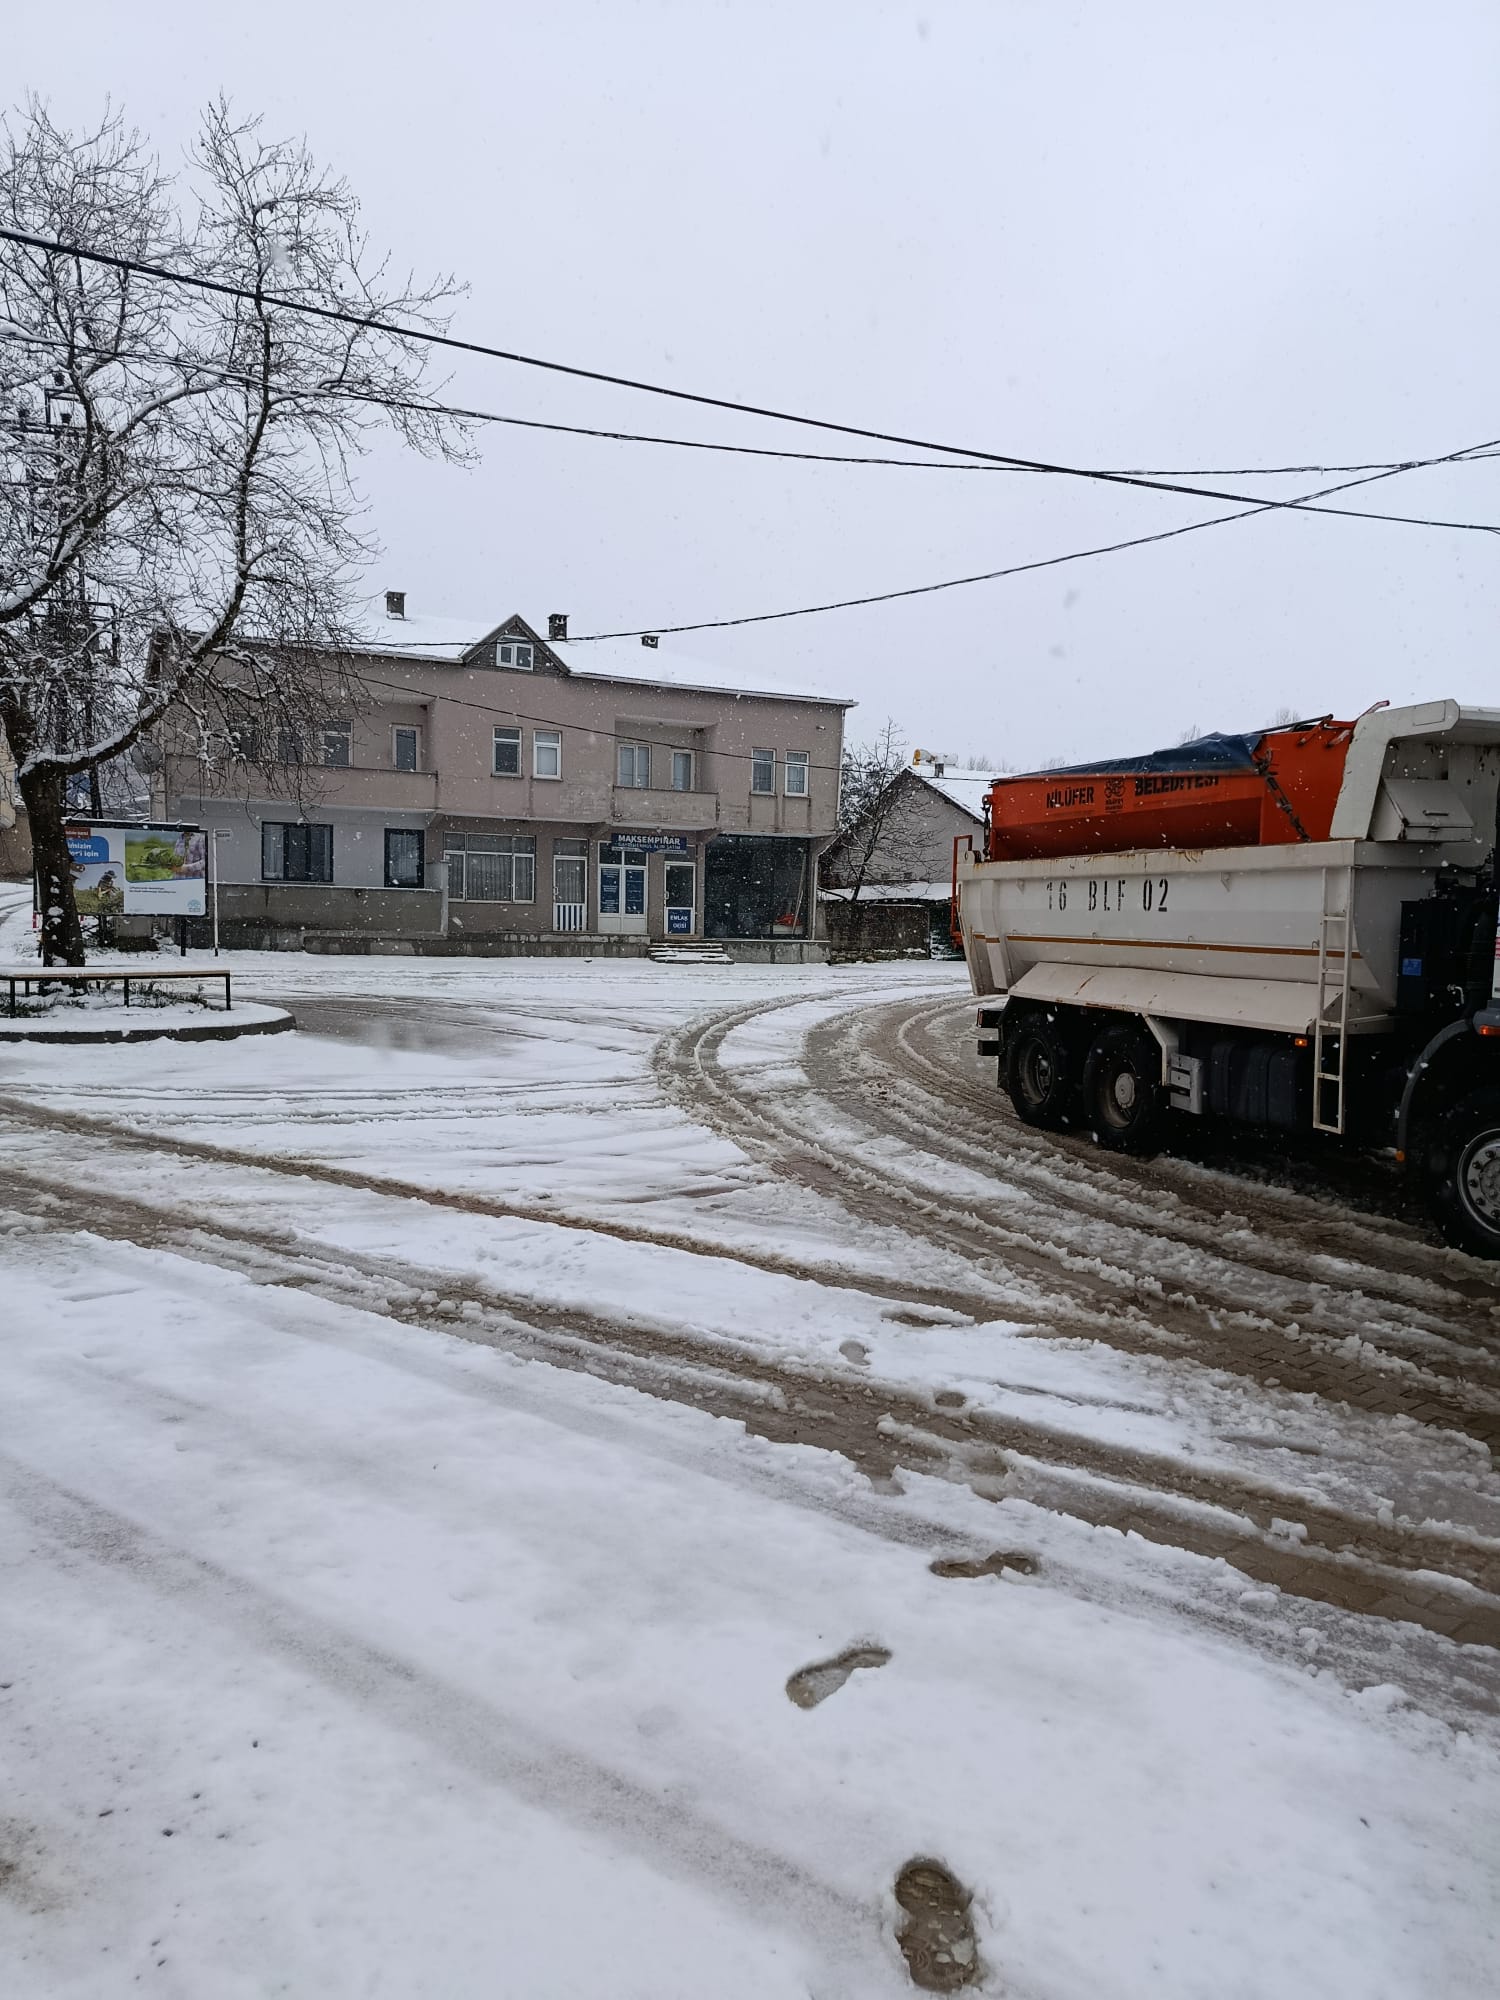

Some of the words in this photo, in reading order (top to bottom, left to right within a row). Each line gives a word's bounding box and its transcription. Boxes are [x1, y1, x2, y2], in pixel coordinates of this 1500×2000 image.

[1046, 881, 1067, 911] 16
[1088, 880, 1126, 911] BLF
[1142, 878, 1169, 912] 02
